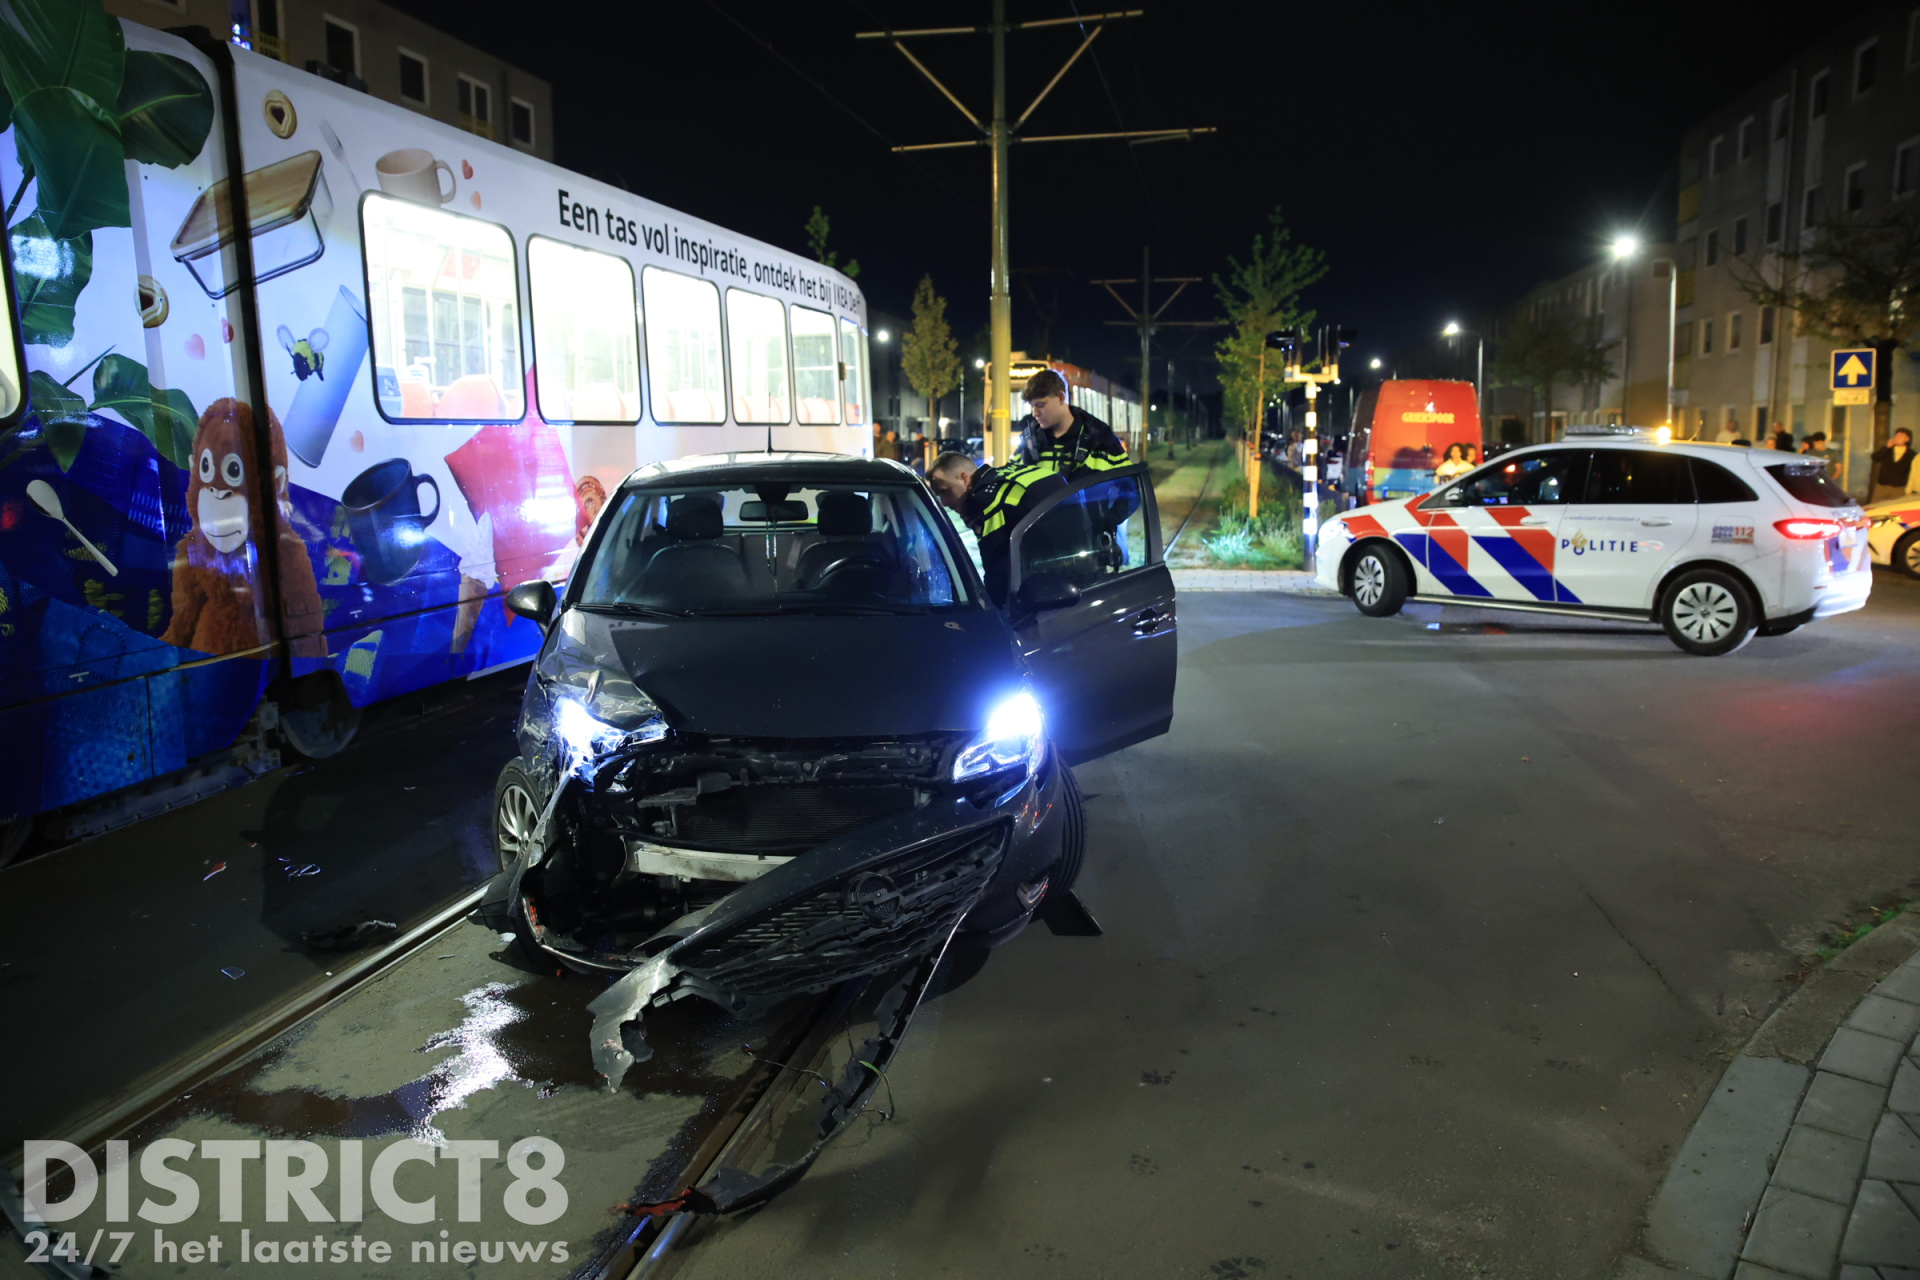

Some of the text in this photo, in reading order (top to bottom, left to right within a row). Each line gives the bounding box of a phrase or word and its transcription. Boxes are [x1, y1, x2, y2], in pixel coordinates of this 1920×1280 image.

[558, 188, 600, 236] Een
[605, 207, 638, 246] tas
[642, 223, 670, 256] vol
[674, 226, 751, 284] inspiratie,
[754, 261, 797, 294] ontdek
[799, 269, 817, 300] het
[819, 276, 832, 310] bij
[1735, 526, 1754, 537] 112
[1561, 539, 1638, 556] POLITIE
